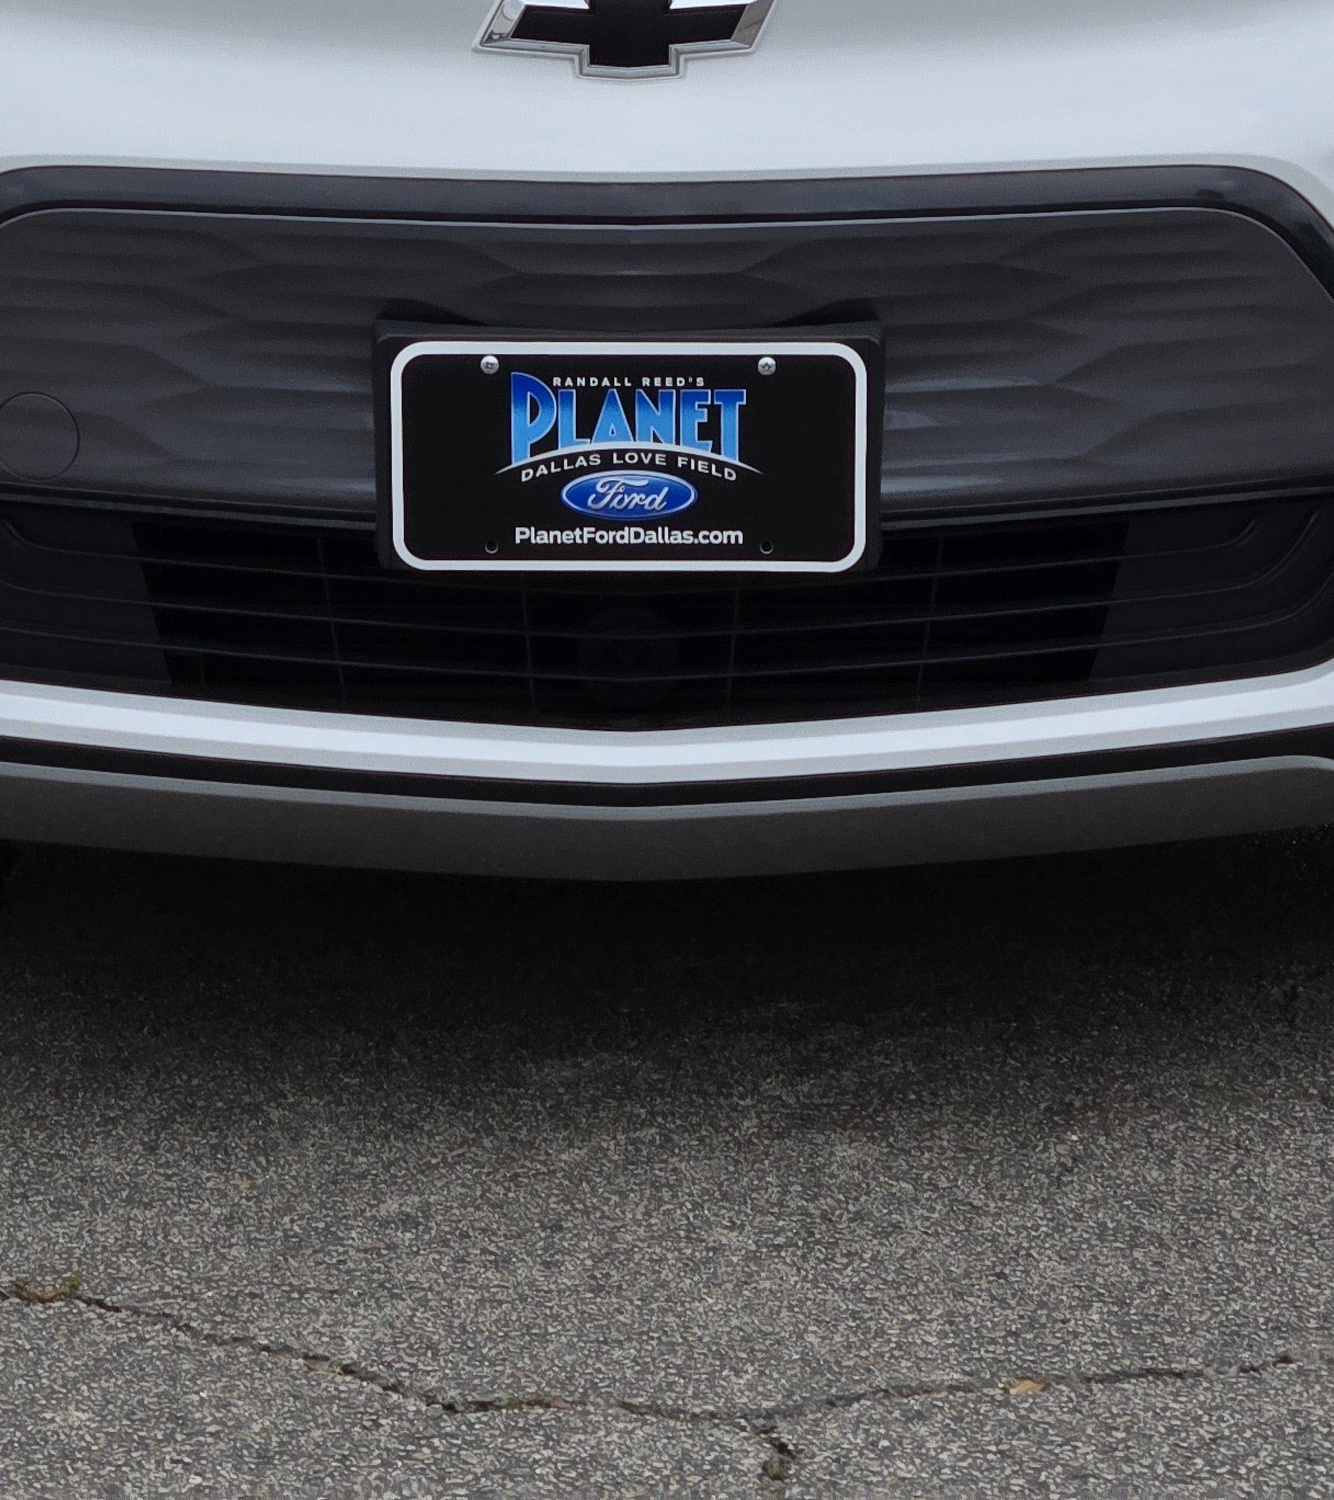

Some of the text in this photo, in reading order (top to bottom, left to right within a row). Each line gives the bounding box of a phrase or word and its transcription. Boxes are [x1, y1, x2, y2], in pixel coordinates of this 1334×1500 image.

[552, 376, 706, 387] RANDALL REED'S
[510, 371, 747, 465] PLANET
[520, 452, 738, 483] DALLAS LOVE FIELD
[586, 475, 670, 512] Ford
[514, 526, 744, 546] PlanetFordDallas.com
